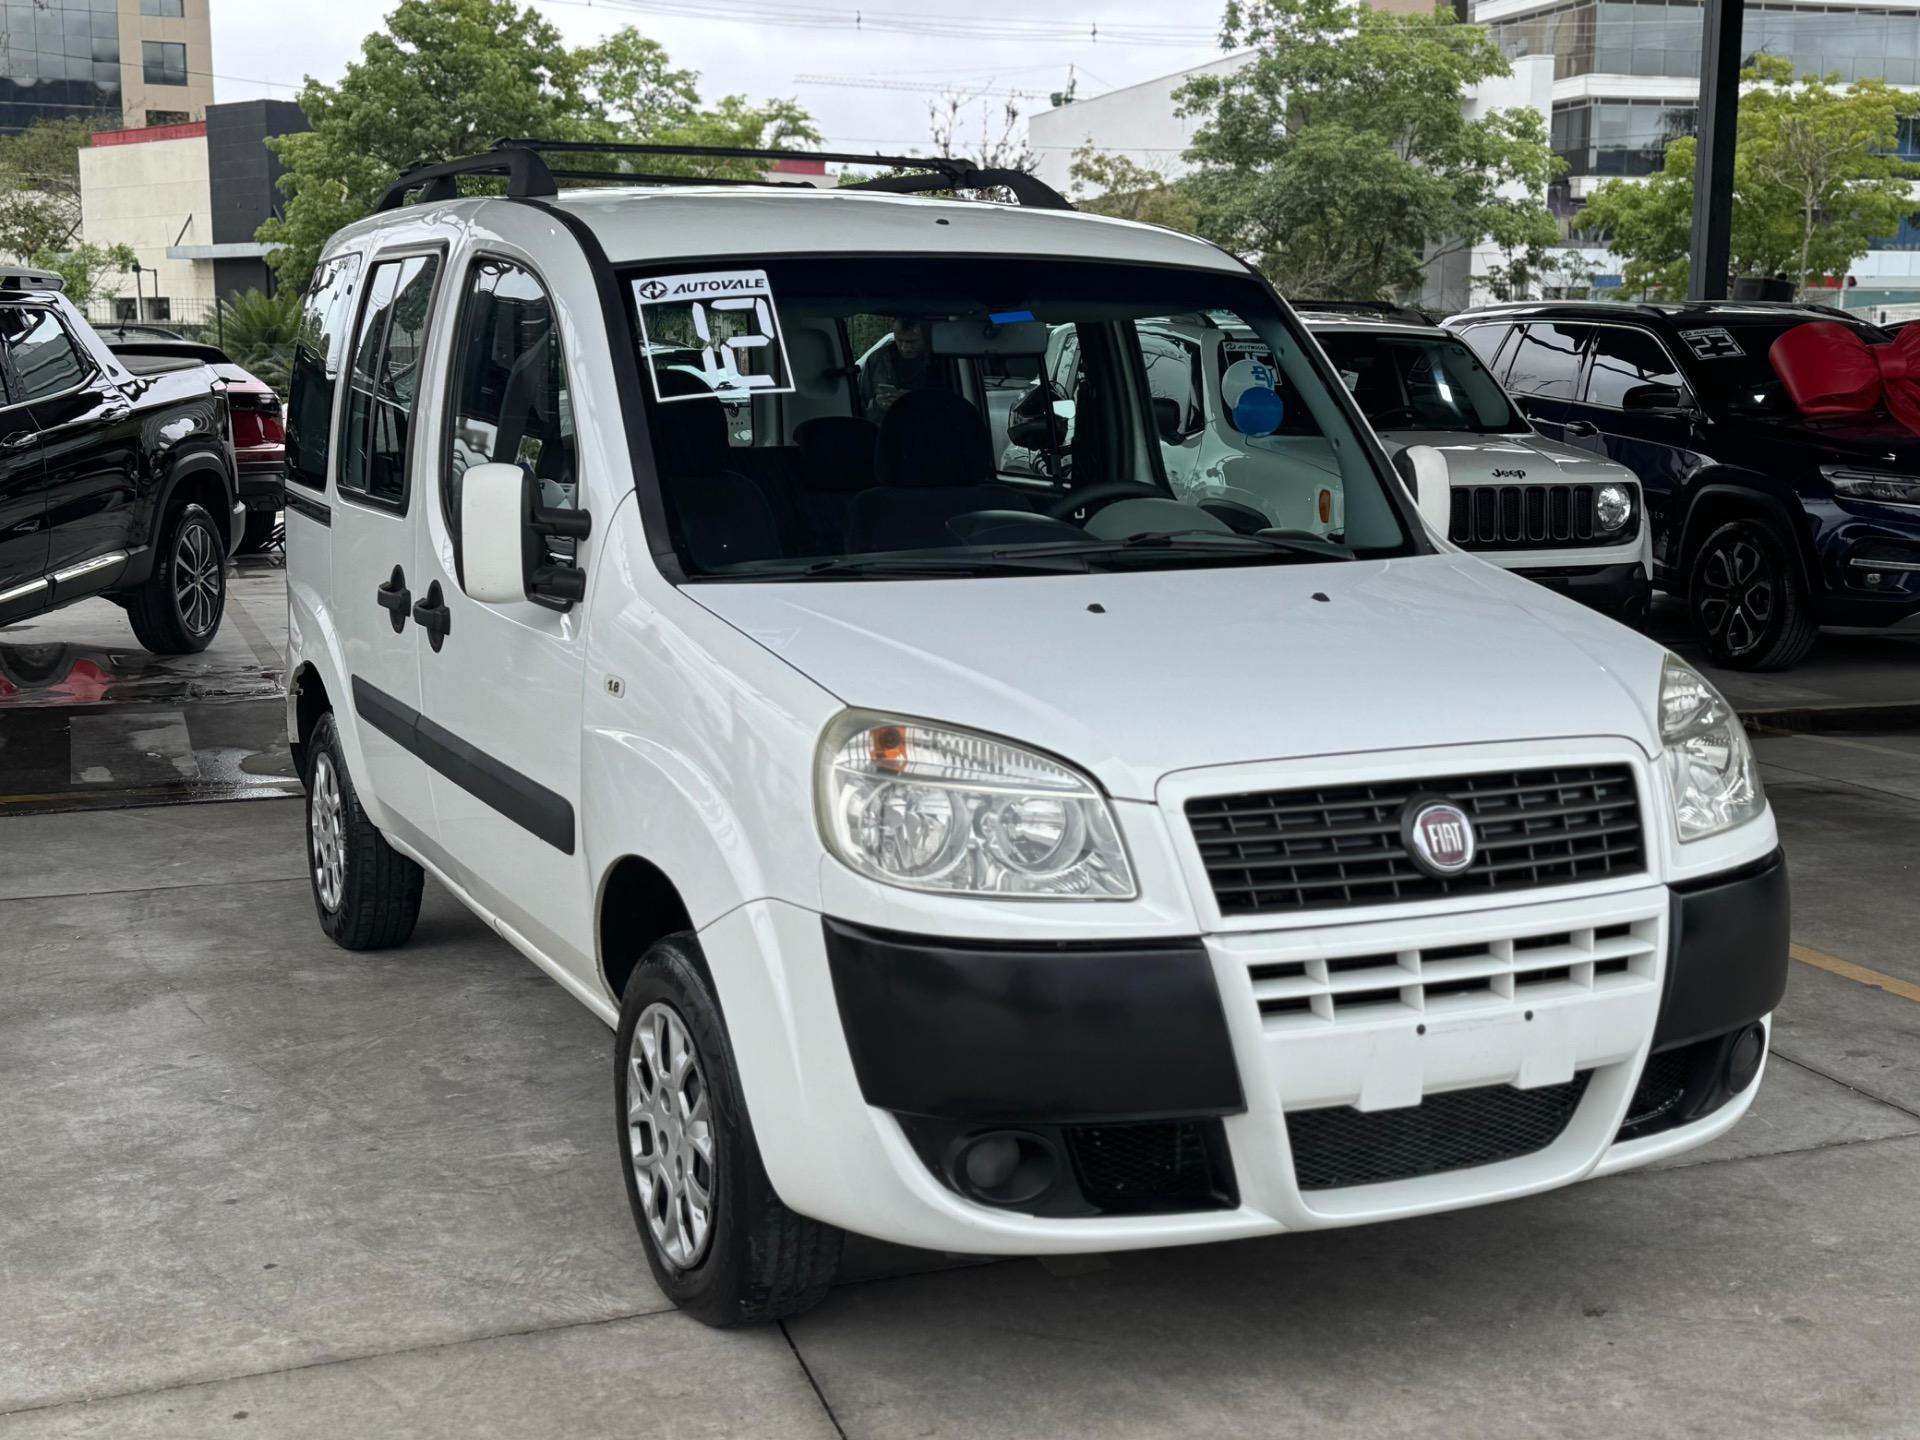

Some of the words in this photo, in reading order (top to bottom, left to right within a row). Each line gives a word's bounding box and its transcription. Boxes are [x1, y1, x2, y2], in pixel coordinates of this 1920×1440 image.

[673, 278, 765, 294] AUTOVALE
[692, 297, 776, 387] 12
[1686, 334, 1742, 357] 23
[1492, 468, 1526, 479] Jeep
[1427, 822, 1463, 853] FIAT
